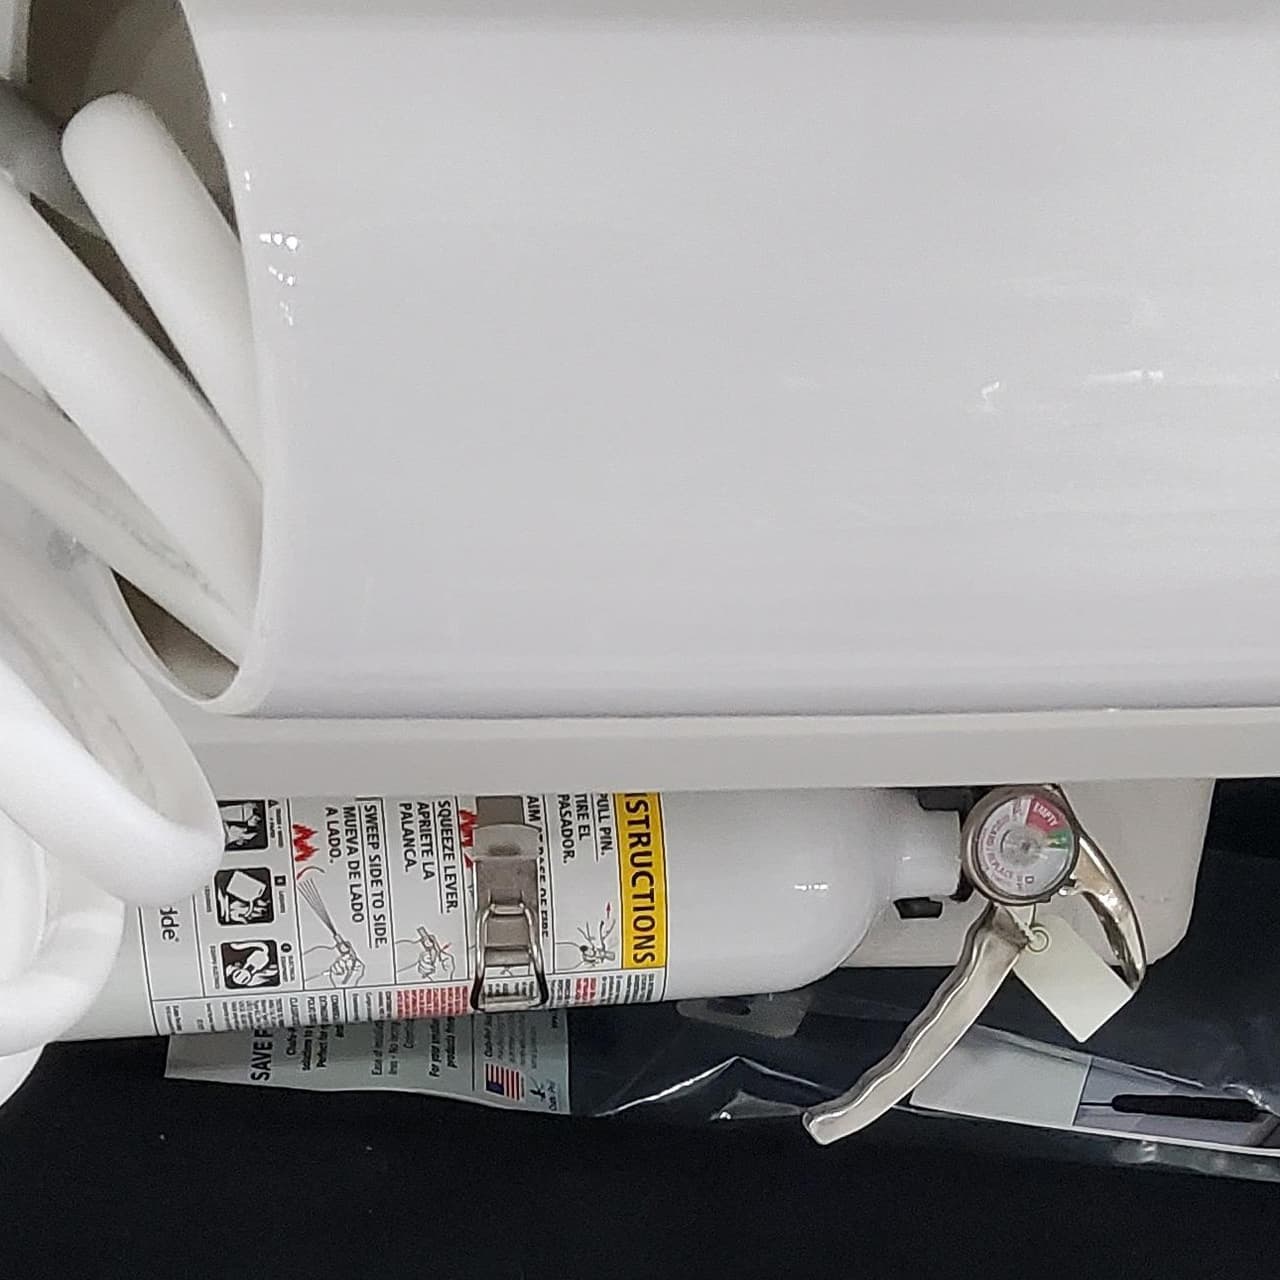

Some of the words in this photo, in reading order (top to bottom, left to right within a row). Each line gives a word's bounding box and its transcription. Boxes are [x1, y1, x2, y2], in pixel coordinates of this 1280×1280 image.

[325, 807, 339, 817] A
[364, 804, 380, 850] SWEEP
[527, 796, 541, 822] AIM
[327, 821, 342, 864] LADO.
[342, 806, 360, 856] MUEVA
[417, 802, 434, 858] APRIETE
[438, 800, 456, 861] SQUEEZE
[557, 794, 575, 864] PASADOR.
[579, 824, 591, 841] EL
[600, 827, 613, 856] PIN.
[347, 861, 361, 880] DE
[369, 854, 383, 887] SIDE
[422, 862, 436, 880] LA
[443, 865, 458, 914] LEVER.
[624, 792, 656, 964] STRUCTIONS
[349, 884, 364, 923] LADO
[372, 891, 385, 909] TO
[373, 914, 388, 949] SIDE.
[250, 1041, 274, 1081] SAVE
